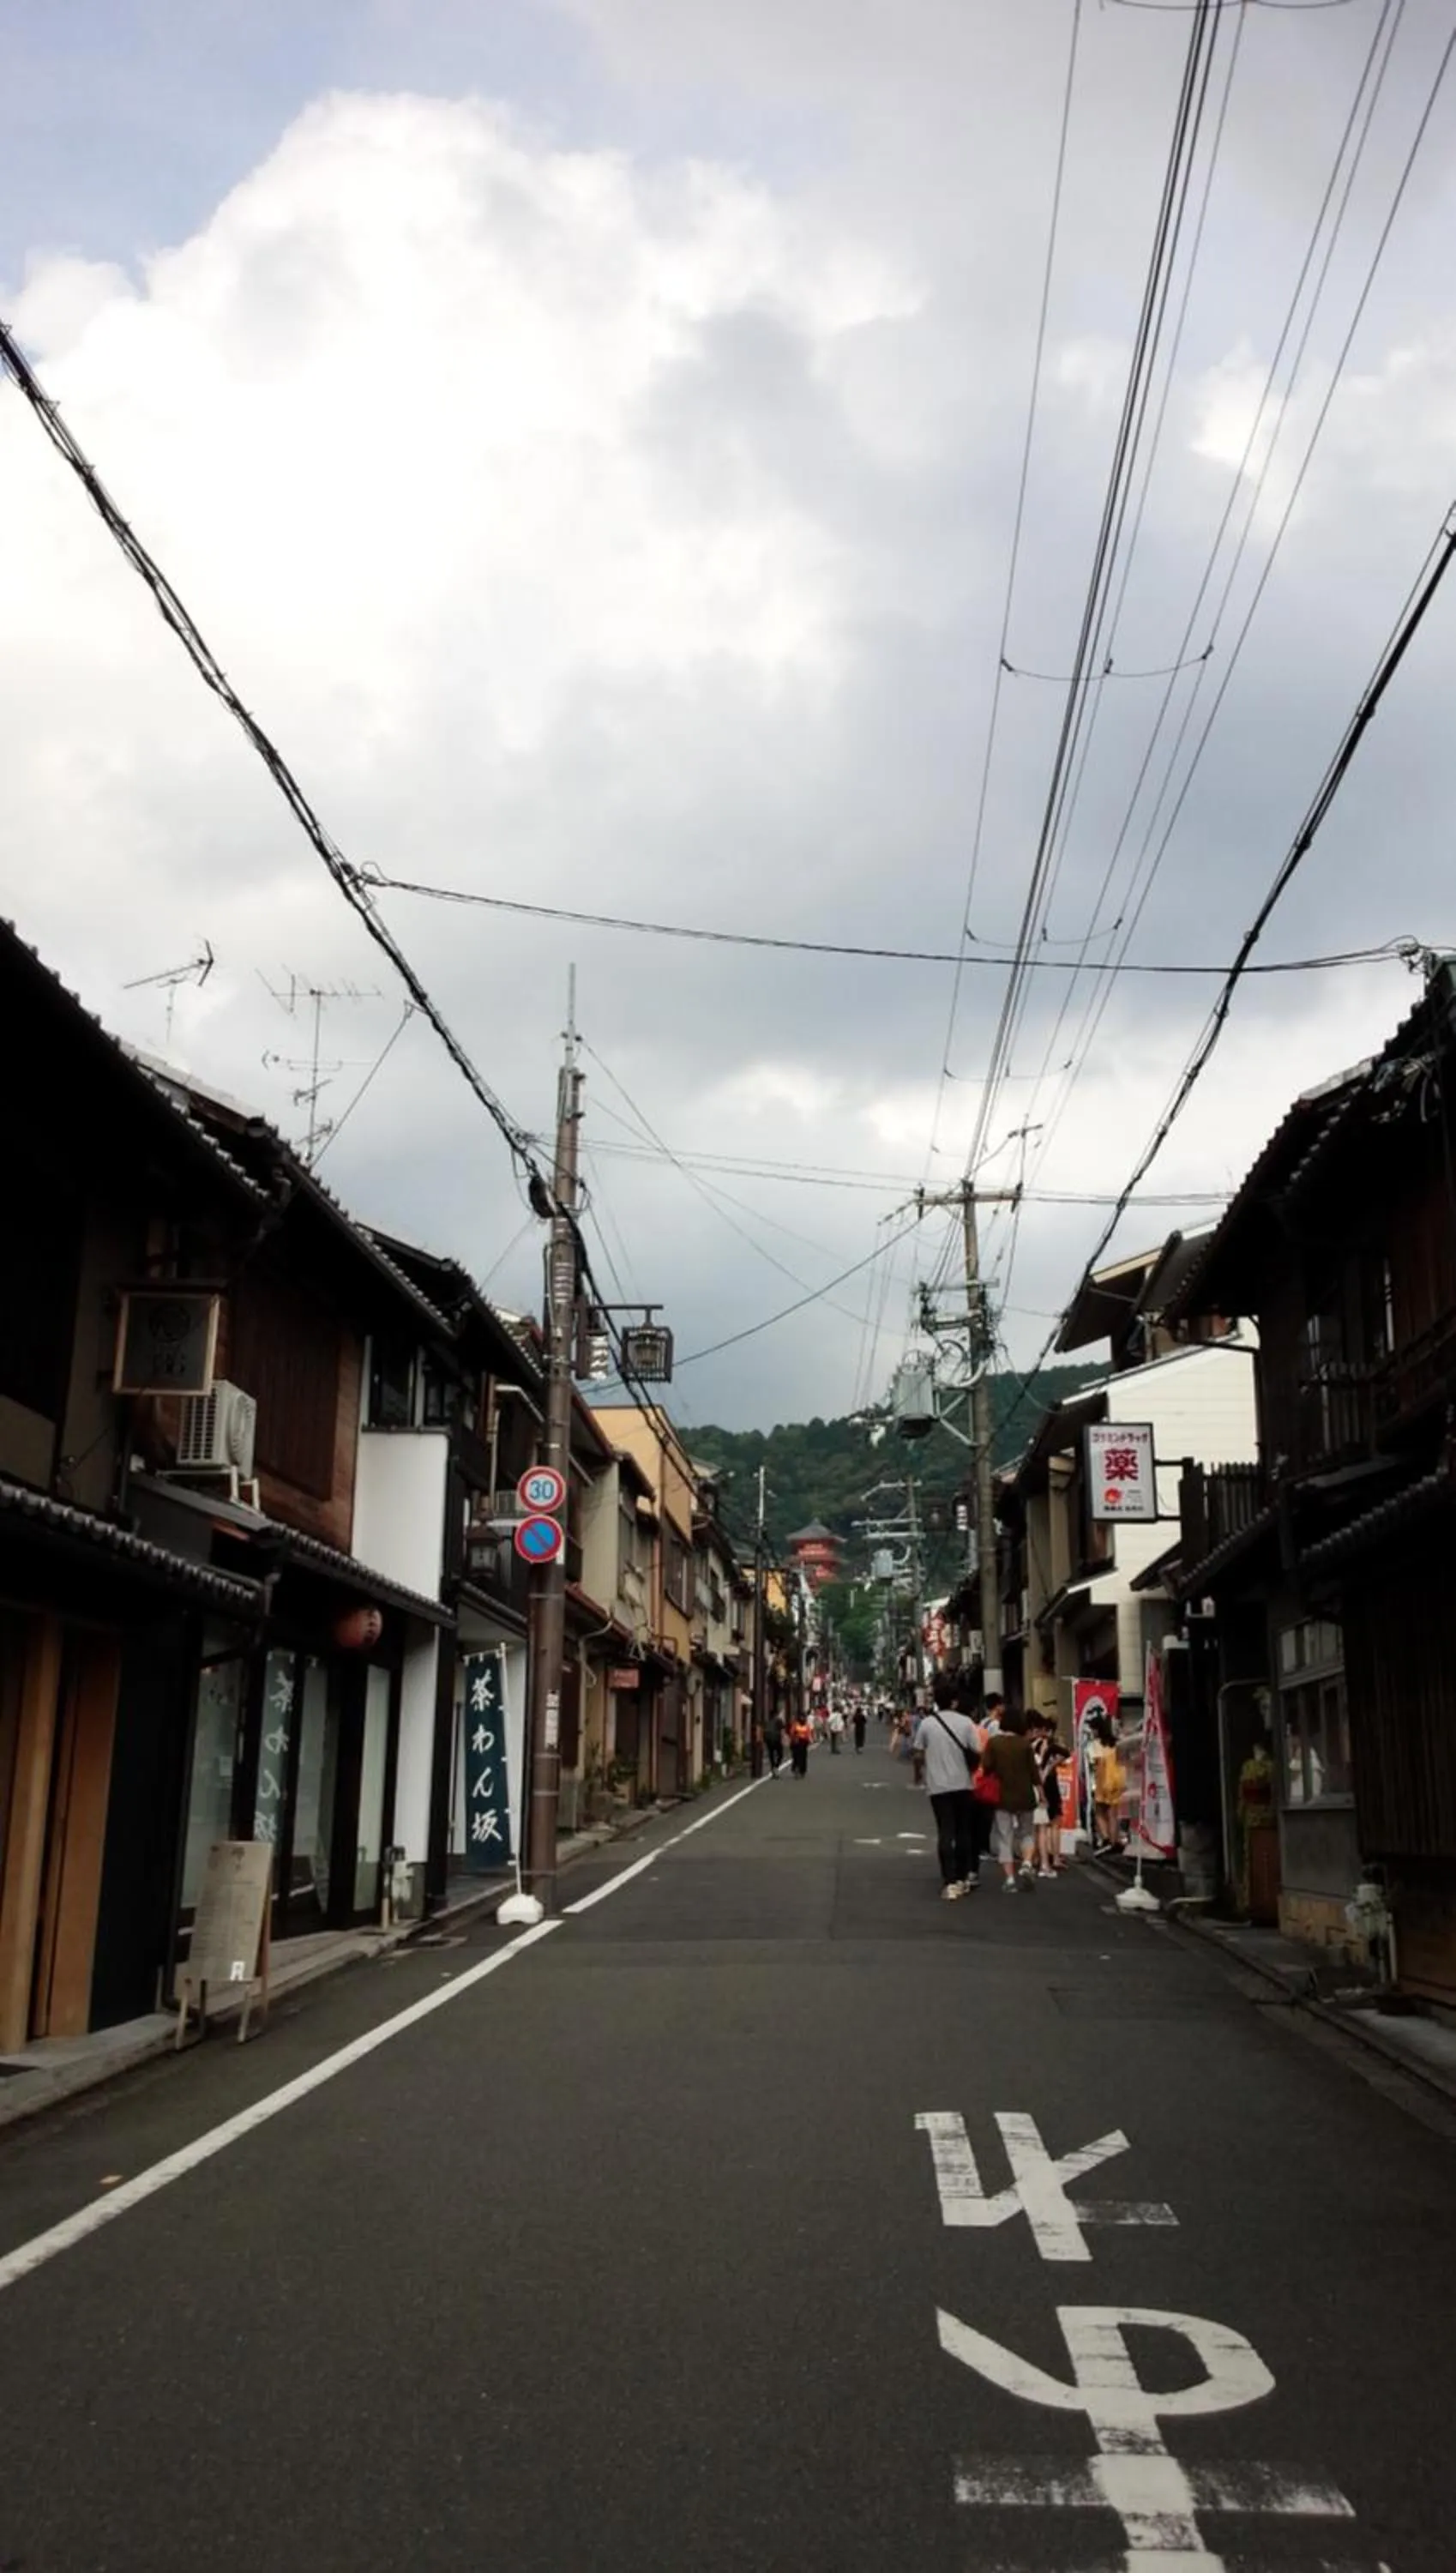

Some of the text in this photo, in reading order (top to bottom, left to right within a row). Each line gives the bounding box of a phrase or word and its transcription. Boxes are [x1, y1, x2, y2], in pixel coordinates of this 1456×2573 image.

[1104, 1448, 1139, 1481] 薬
[530, 1480, 555, 1500] 30
[471, 1669, 502, 1841] 茶わん坂
